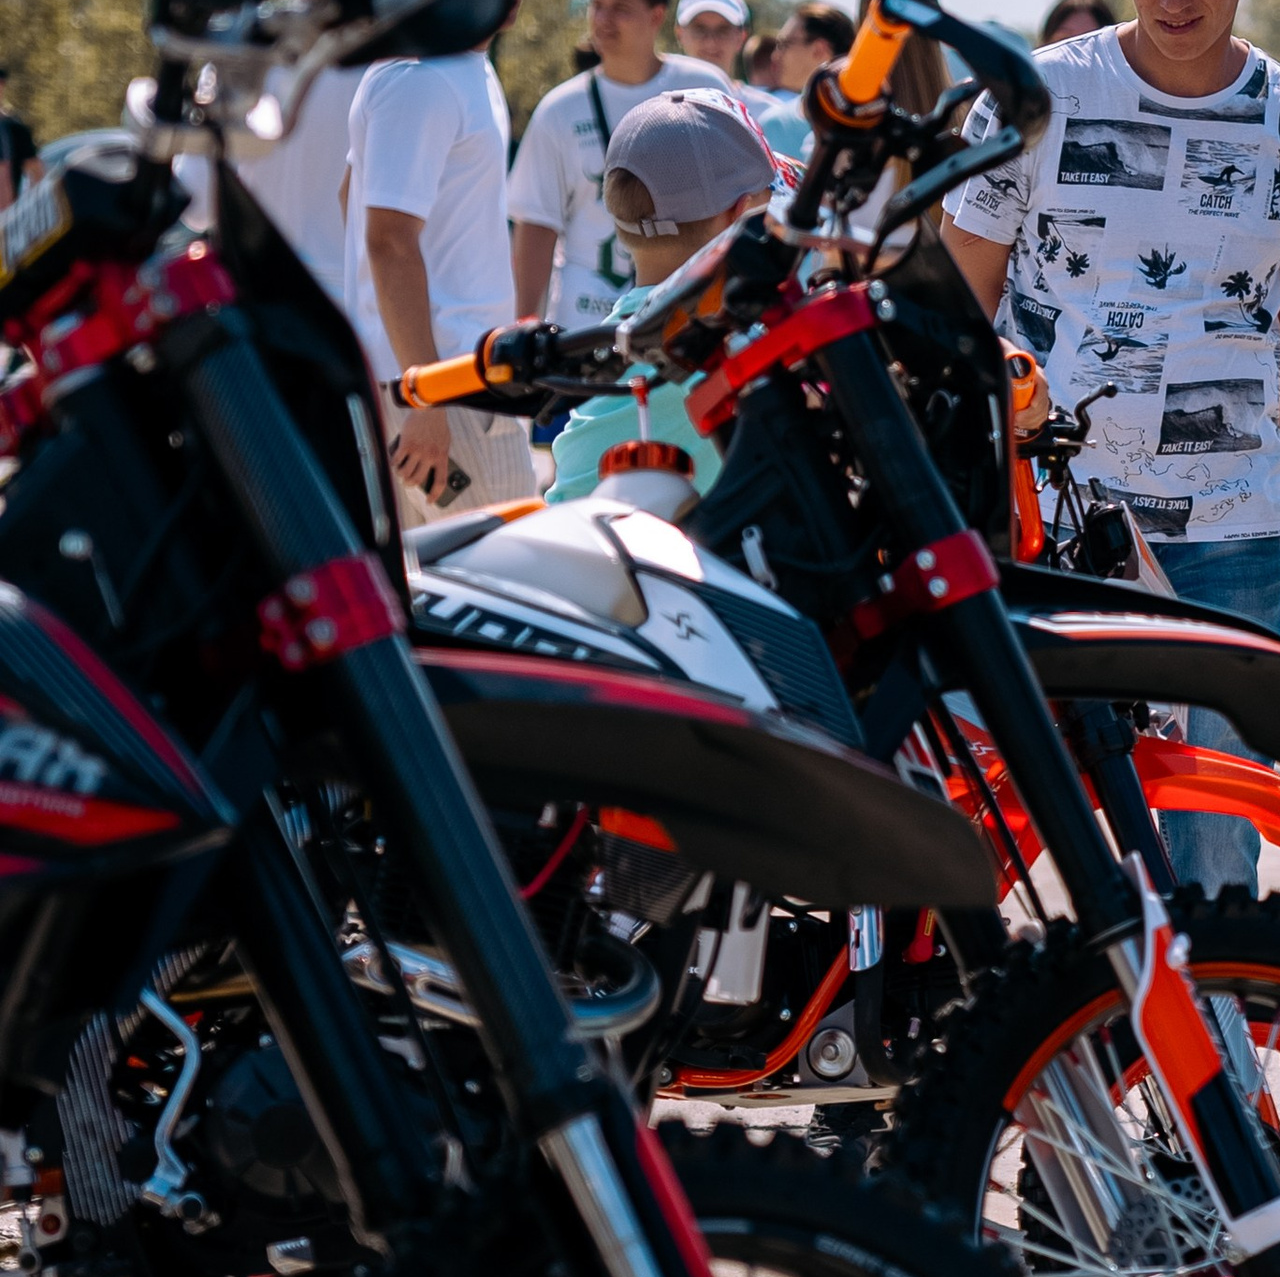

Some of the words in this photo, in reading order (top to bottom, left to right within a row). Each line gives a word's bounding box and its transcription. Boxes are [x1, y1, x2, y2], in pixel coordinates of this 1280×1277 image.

[1060, 171, 1079, 183] TAKE
[1080, 171, 1089, 183] IT
[1089, 172, 1111, 184] EASY
[1199, 193, 1233, 210] CATCH
[1187, 208, 1198, 216] THE
[1199, 209, 1223, 217] PERFECT
[1224, 211, 1241, 219] WAVE
[1116, 301, 1145, 310] PERFECT
[1105, 310, 1145, 329] CATCH
[1161, 441, 1183, 453] TAKE
[1183, 441, 1192, 453] IT
[1193, 440, 1214, 453] EASY
[1131, 495, 1156, 508] EASY
[1155, 498, 1167, 509] IT
[1166, 498, 1190, 511] TAKE
